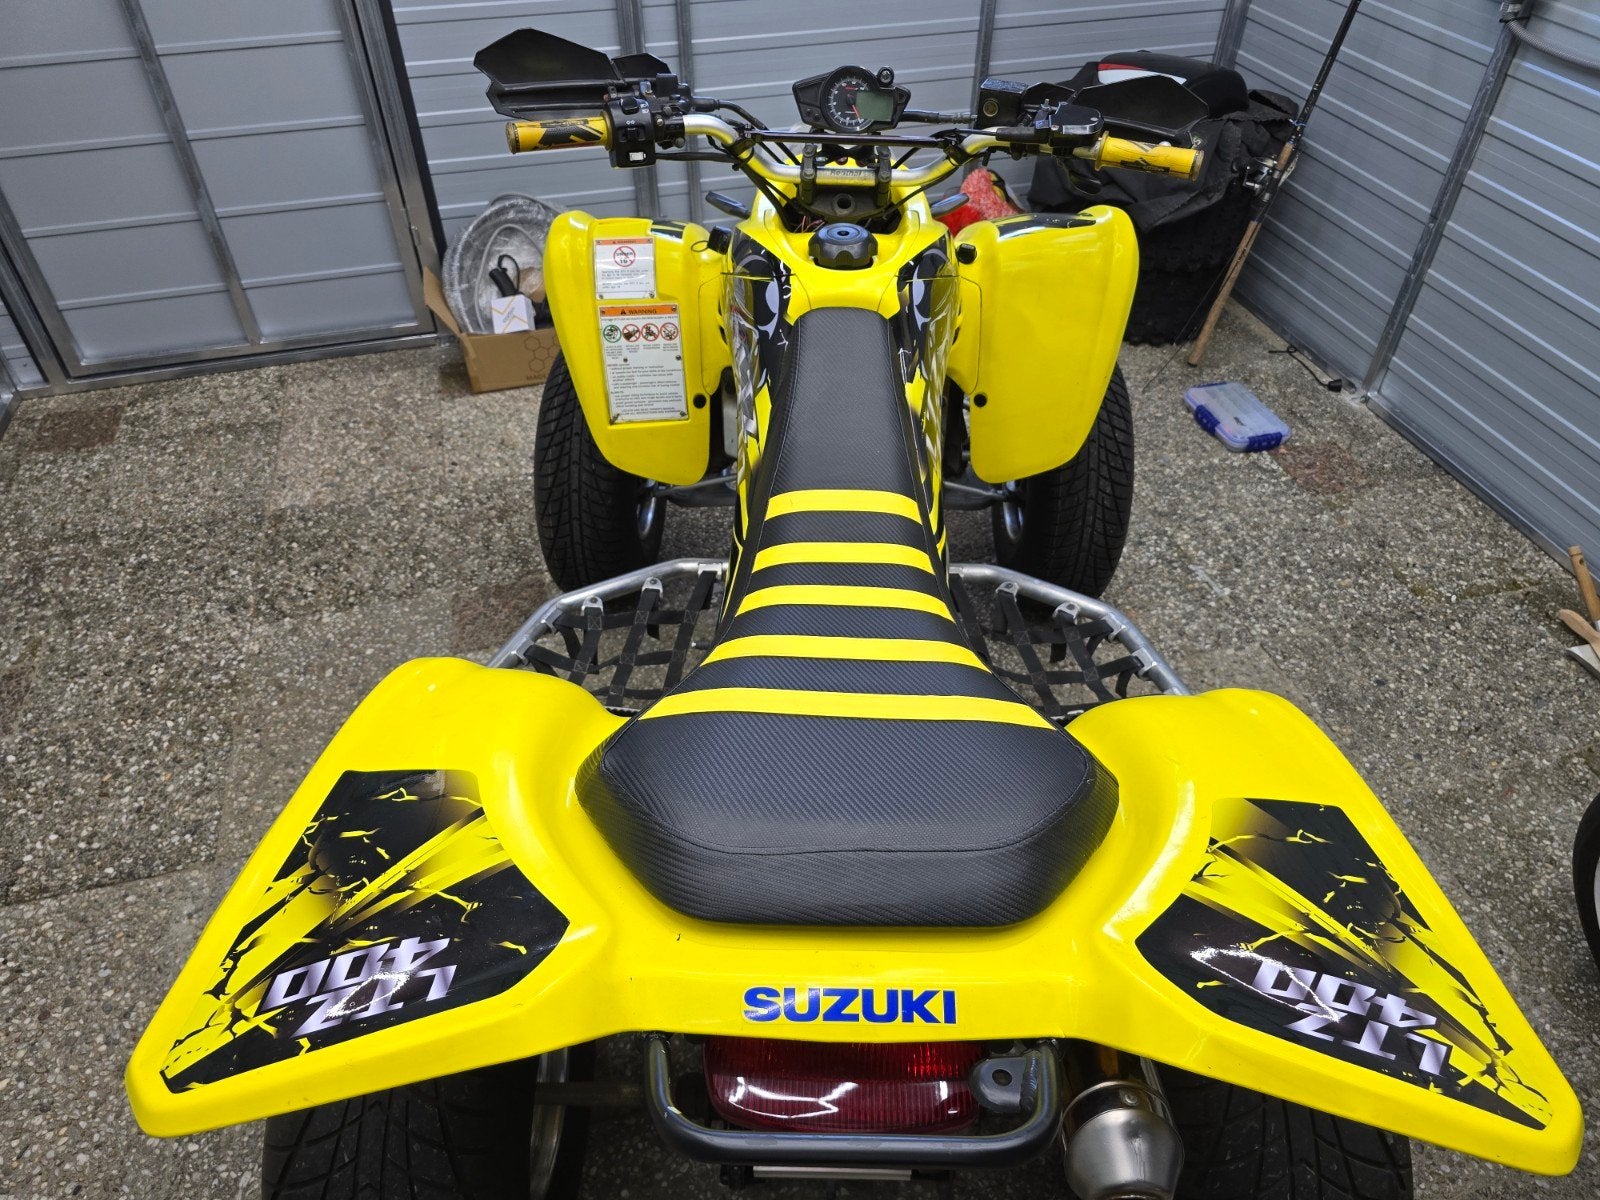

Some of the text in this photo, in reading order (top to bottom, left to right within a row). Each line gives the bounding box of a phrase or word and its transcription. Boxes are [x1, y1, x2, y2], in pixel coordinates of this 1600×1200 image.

[256, 936, 451, 1012] 400
[743, 986, 957, 1025] SUZUKI
[1250, 959, 1438, 1029] 400
